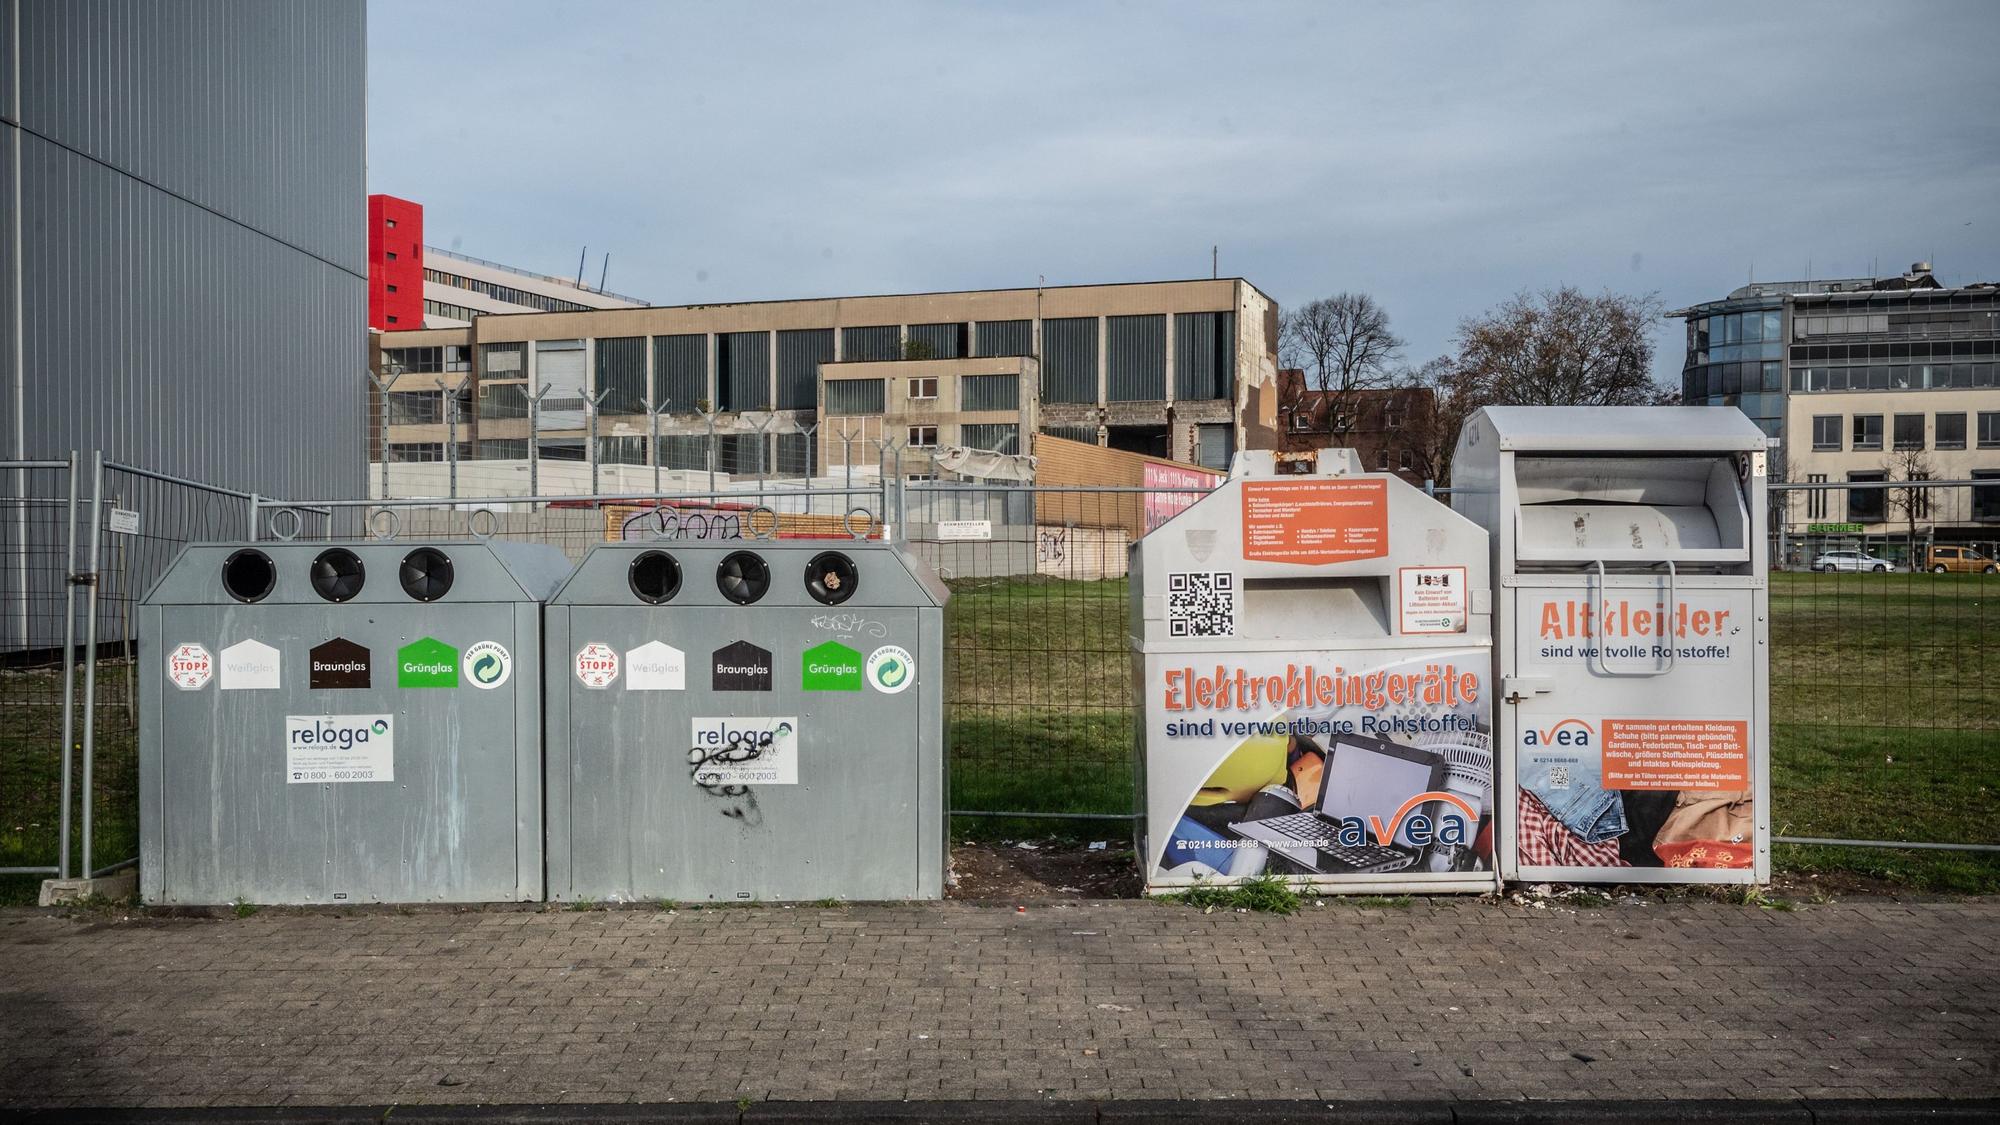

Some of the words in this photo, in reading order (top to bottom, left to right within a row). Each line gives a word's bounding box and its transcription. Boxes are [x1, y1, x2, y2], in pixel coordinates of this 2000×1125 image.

[1540, 600, 1730, 640] Altkleider
[1541, 646, 1573, 658] sind
[1578, 646, 1646, 658] wetvolle
[174, 662, 208, 671] STOPP
[228, 664, 274, 674] Weißglas
[314, 661, 366, 673] Braunglas
[404, 662, 452, 674] Grünglas
[580, 661, 614, 670] STOPP
[632, 664, 680, 674] Weißglas
[717, 664, 768, 676] Braunglas
[809, 664, 857, 676] Grünglas
[1164, 664, 1478, 710] Elektrokleingeräte
[1166, 718, 1212, 736] sind
[1221, 716, 1353, 736] verwertbare
[1362, 713, 1478, 734] Rohstoffe!
[1612, 724, 1624, 732] Wir
[1626, 724, 1656, 732] sammeln
[1658, 724, 1670, 732] gut
[1671, 724, 1703, 732] erhaltene
[293, 720, 368, 750] reloga
[698, 722, 773, 750] reloga
[1524, 719, 1594, 746] avea
[1614, 732, 1638, 741] Schuhe
[1641, 732, 1658, 741] (bitte
[1660, 732, 1696, 741] paarweise
[1709, 742, 1722, 750] und
[1635, 751, 1661, 760] größere
[1706, 751, 1743, 760] Plüschtiere
[1628, 761, 1641, 769] und
[1643, 761, 1670, 769] intaktes
[757, 772, 777, 780] 2003
[1338, 791, 1479, 848] avea
[1188, 840, 1212, 850] 0214
[1214, 840, 1258, 850] 8668-668
[1268, 838, 1329, 848] www.avea.de
